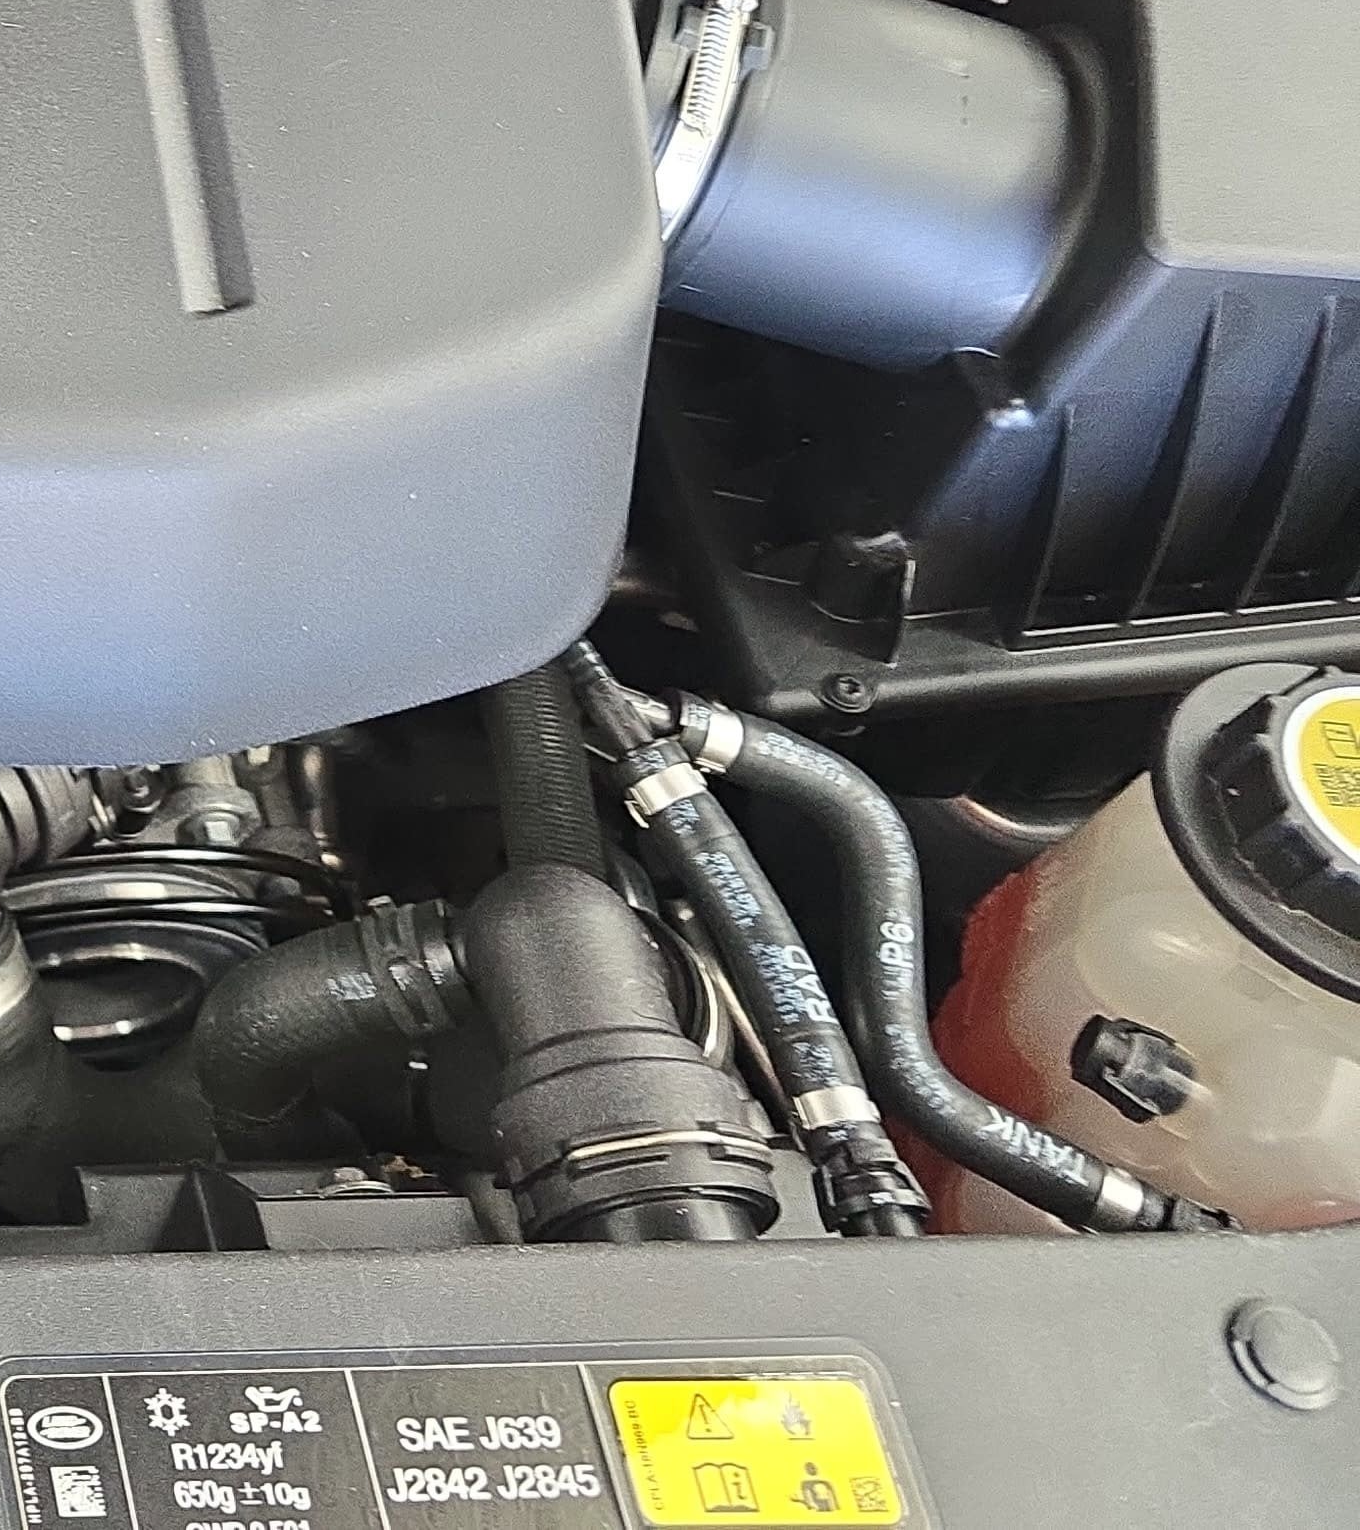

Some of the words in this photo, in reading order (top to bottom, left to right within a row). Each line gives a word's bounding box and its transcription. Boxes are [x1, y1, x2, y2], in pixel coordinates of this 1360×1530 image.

[229, 1410, 323, 1434] SP-A2
[396, 1416, 475, 1452] SAE
[480, 1415, 562, 1451] J639
[170, 1440, 284, 1476] R1234yf
[173, 1479, 237, 1515] 650g
[387, 1466, 493, 1503] J2842
[496, 1463, 602, 1501] J2845
